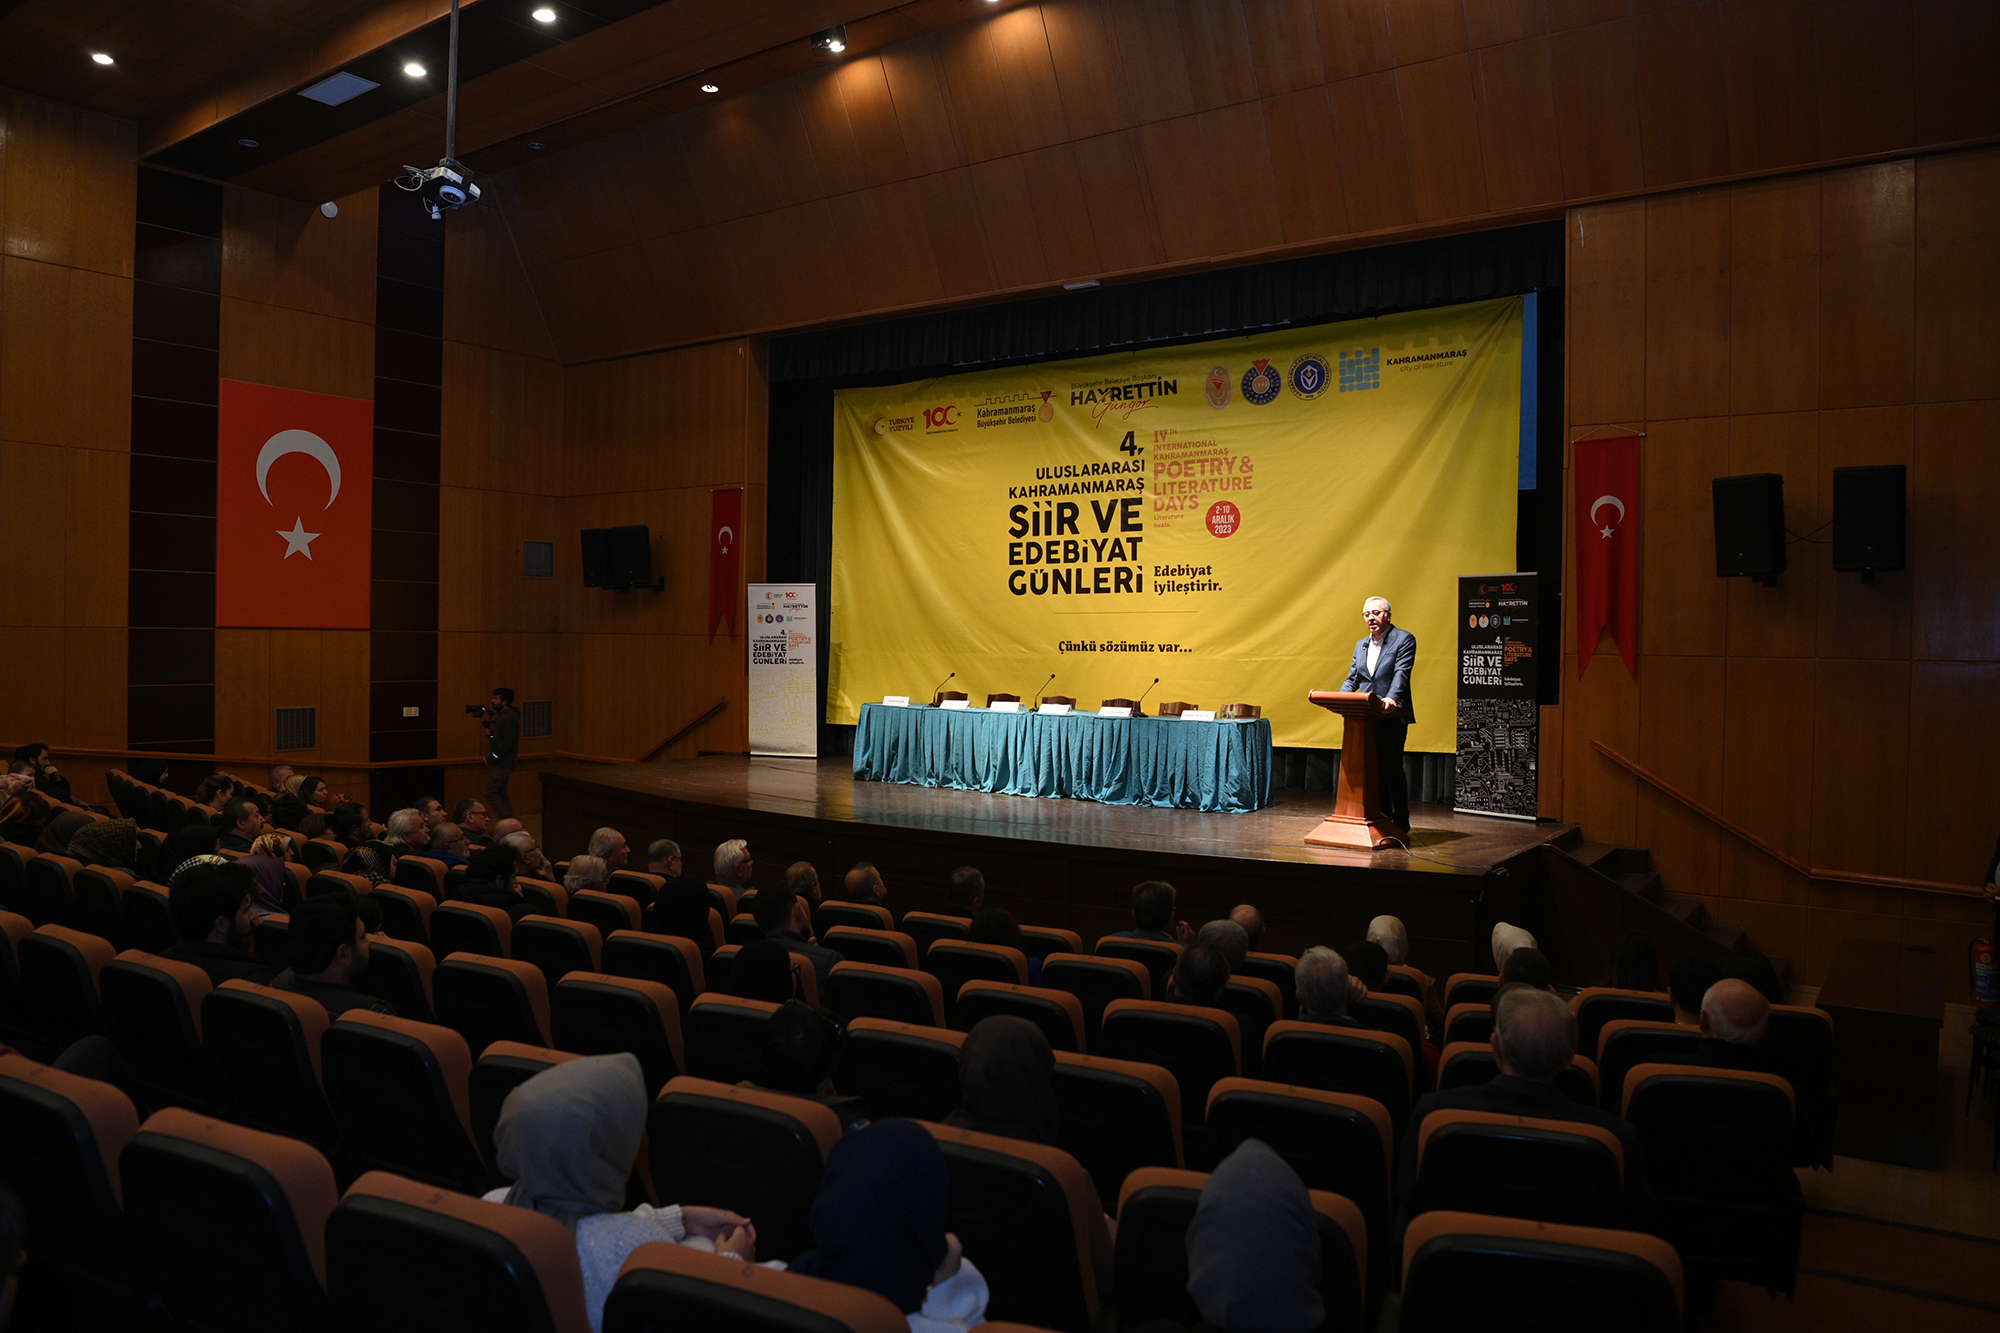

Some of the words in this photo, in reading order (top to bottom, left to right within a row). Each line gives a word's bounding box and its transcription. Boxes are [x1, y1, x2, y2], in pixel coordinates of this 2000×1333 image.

[1387, 349, 1468, 366] KAHRAMANMARAŞ
[1400, 363, 1413, 372] city
[1414, 362, 1421, 370] of
[1422, 360, 1454, 370] literature
[1070, 376, 1178, 406] HAYRETTİN
[977, 404, 1036, 418] Kahramanmaraş
[1008, 414, 1036, 424] Belediyesi
[1153, 440, 1218, 452] INTERNATIONAL
[1153, 448, 1229, 460] KAHRAMANMARAŞ
[1036, 459, 1145, 480] ULUSLARARASI
[1153, 456, 1238, 480] POETRY
[1239, 455, 1254, 474] &
[1009, 477, 1145, 499] KAHRAMANMARAŞ
[1153, 476, 1253, 496] LITERATURE
[1153, 494, 1199, 512] DAYS
[1215, 505, 1231, 514] 2-10
[1091, 497, 1143, 533] VE
[1211, 514, 1235, 525] ARALIK
[1214, 525, 1232, 534] 2023
[1153, 564, 1212, 579] Edebiyat
[1153, 579, 1223, 595] iyileştirir.
[774, 643, 787, 651] VE
[1058, 641, 1097, 655] Çünkü
[1099, 640, 1155, 653] sözümüz
[1158, 643, 1193, 653] var...
[1487, 656, 1502, 667] VE
